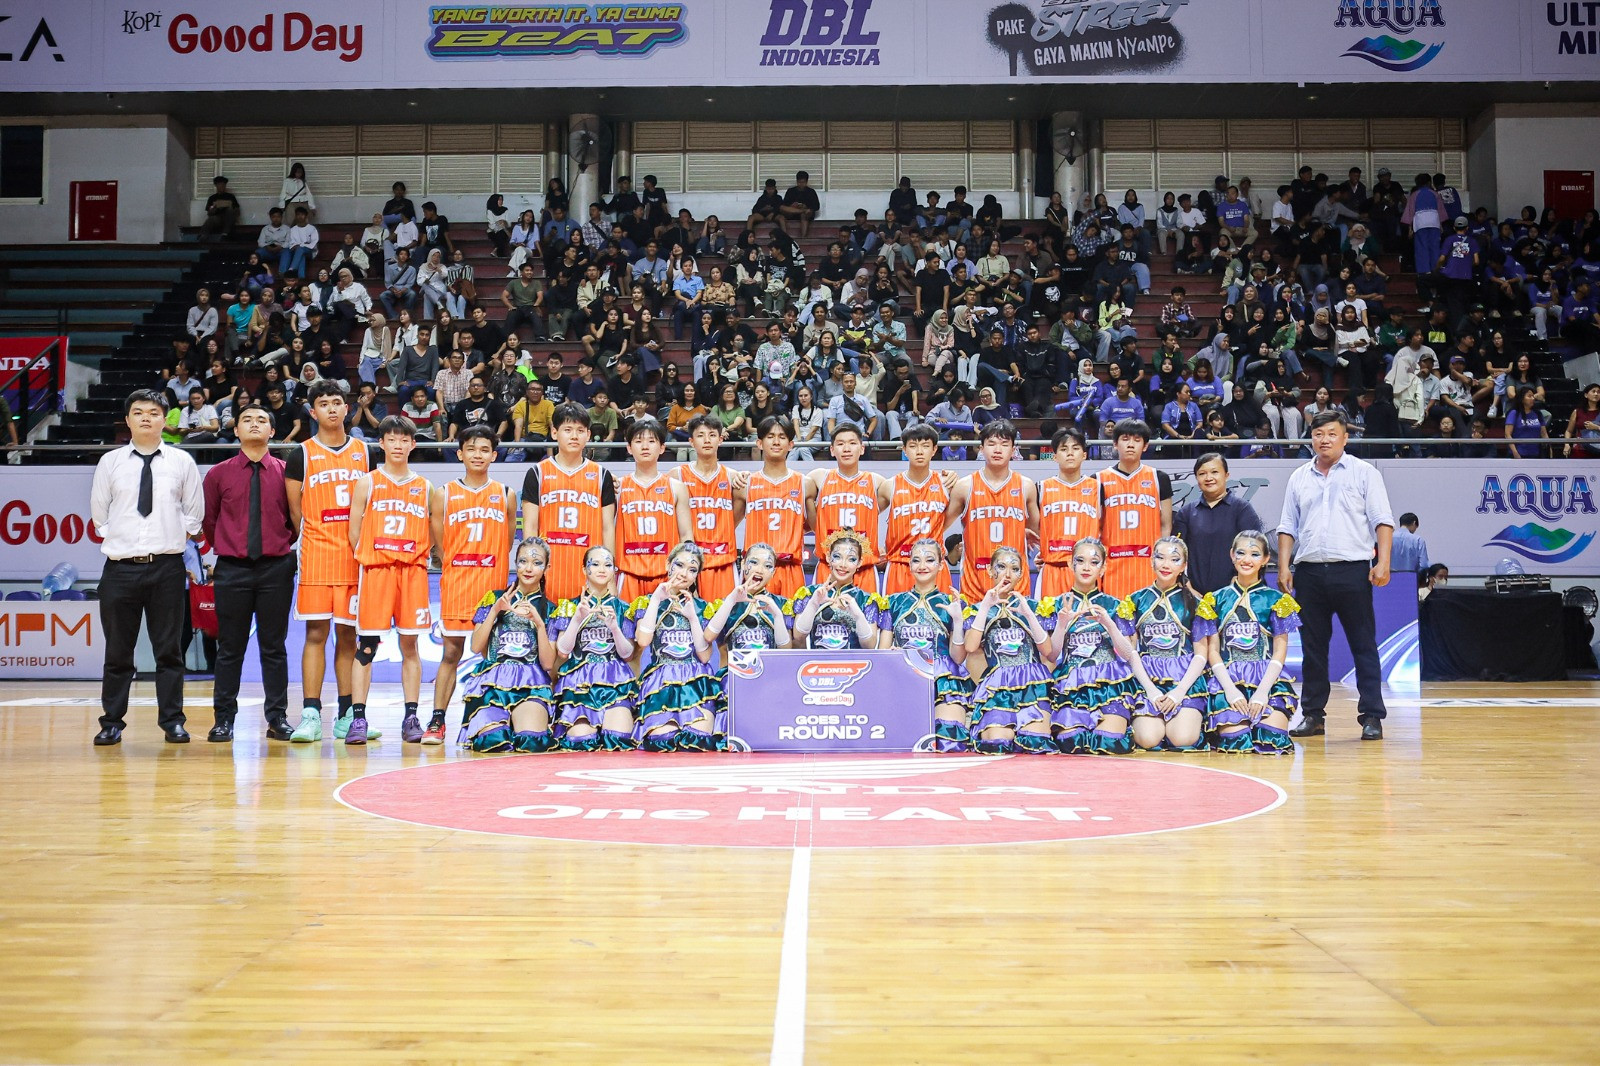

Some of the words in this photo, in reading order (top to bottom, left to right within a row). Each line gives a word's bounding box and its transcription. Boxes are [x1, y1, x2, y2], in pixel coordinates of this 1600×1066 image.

[432, 8, 487, 23] YANG
[491, 8, 560, 23] WORTH
[596, 7, 623, 22] YA
[624, 7, 681, 22] CUMA
[759, 0, 880, 46] DBL
[1030, 0, 1189, 42] STREET
[1334, 0, 1446, 35] AQUA
[1547, 2, 1600, 26] ULT
[997, 19, 1026, 36] PAKE
[168, 13, 273, 54] Good
[284, 12, 363, 62] Day
[1558, 31, 1600, 55] MI
[759, 49, 880, 66] INDONESIA
[1034, 48, 1066, 66] GAYA
[1070, 41, 1114, 63] MAKIN
[1119, 250, 1137, 262] GAP
[335, 485, 350, 507] 6
[383, 515, 406, 535] 27
[558, 507, 578, 529] 13
[637, 516, 657, 535] 10
[697, 513, 716, 530] 20
[768, 513, 781, 531] 2
[838, 508, 856, 527] 16
[910, 517, 931, 536] 26
[1063, 516, 1077, 536] 11
[1119, 510, 1139, 530] 19
[467, 523, 483, 542] 71
[989, 521, 1004, 543] 0
[0, 613, 91, 647] PM
[661, 629, 693, 644] AQUA
[815, 623, 849, 638] AQUA
[900, 625, 934, 640] AQUA
[1144, 622, 1180, 637] AQUA
[1226, 621, 1260, 637] AQUA
[0, 656, 75, 667] STRIBUTOR
[817, 677, 836, 686] DBL
[839, 695, 852, 704] Day
[795, 715, 841, 725] GOES
[844, 714, 869, 725] TO
[778, 726, 863, 740] ROUND
[869, 725, 886, 740] 2
[529, 784, 1079, 795] HONDA
[496, 804, 711, 820] One
[737, 807, 1114, 821] HEART.
